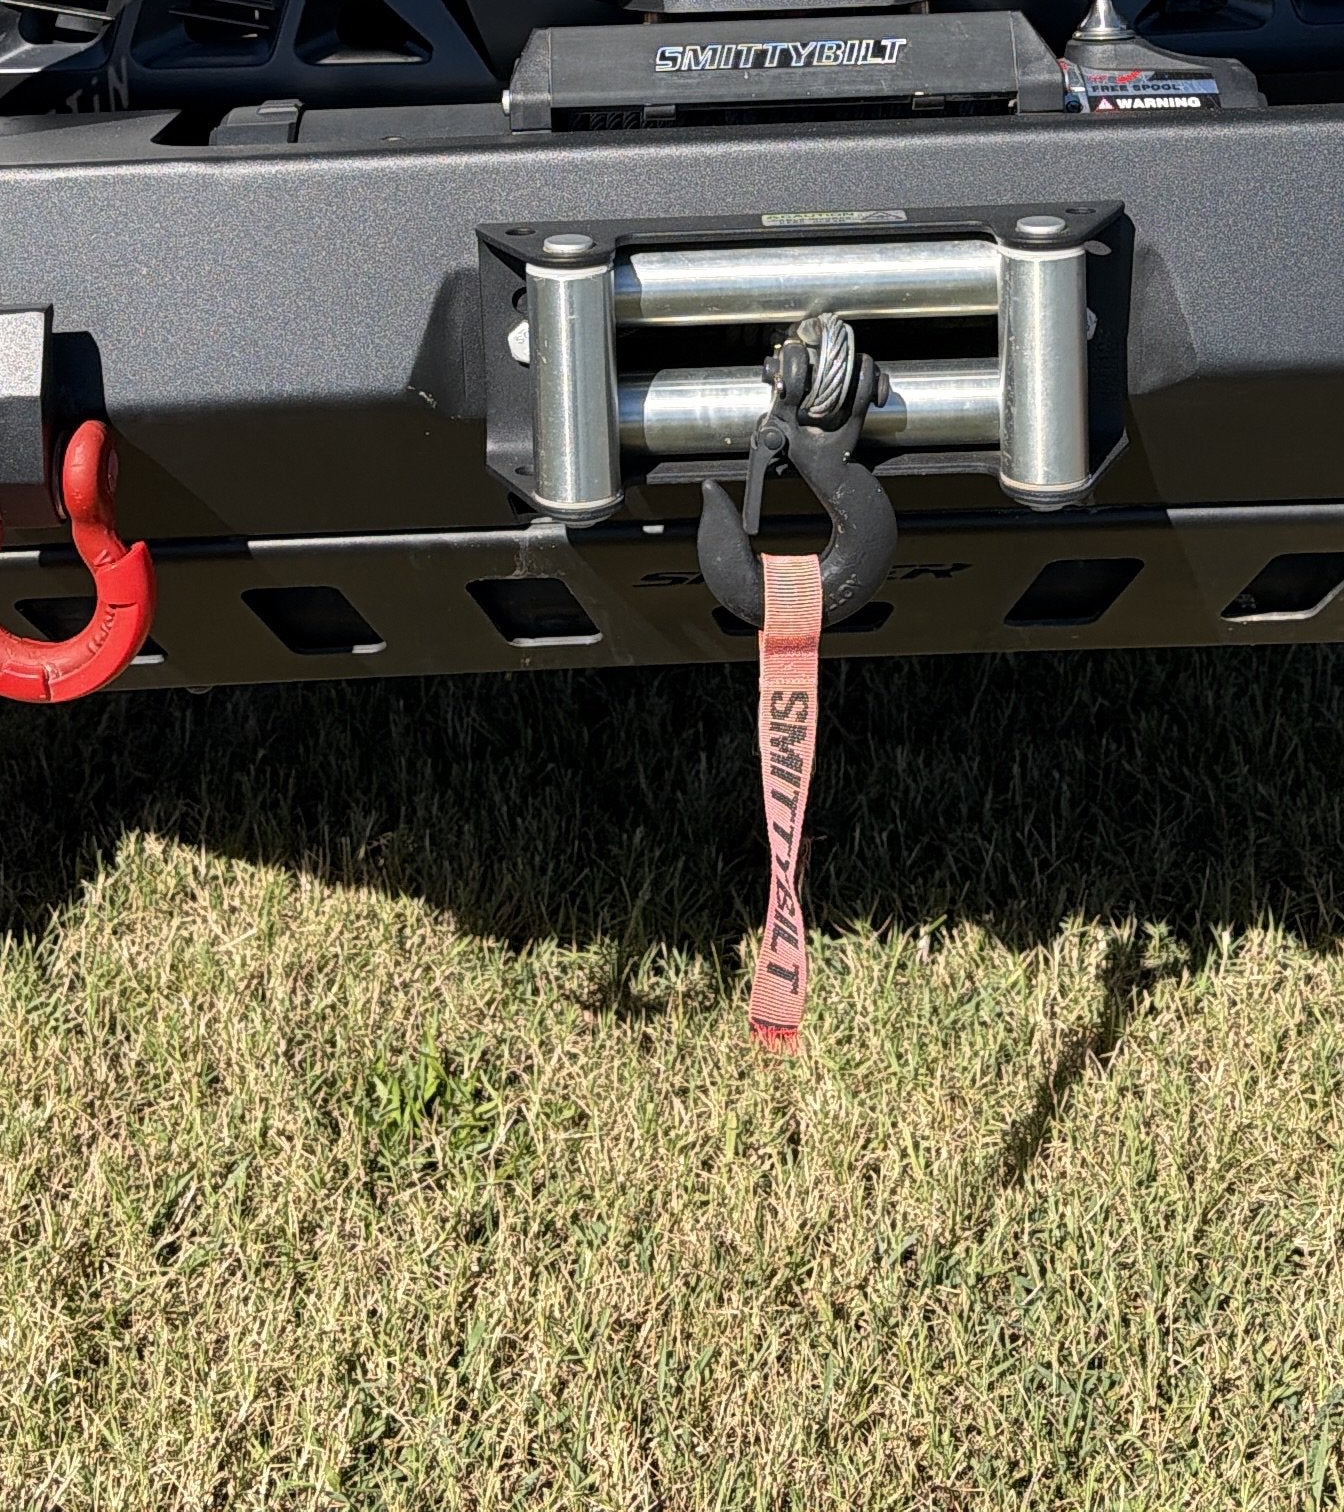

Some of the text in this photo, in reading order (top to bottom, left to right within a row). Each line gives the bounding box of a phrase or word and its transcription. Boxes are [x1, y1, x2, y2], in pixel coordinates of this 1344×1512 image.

[655, 38, 907, 72] SMITTYBILT
[1132, 83, 1181, 92] SPOOL
[1115, 96, 1202, 110] WARNING
[766, 690, 810, 996] SMITTYBILT
